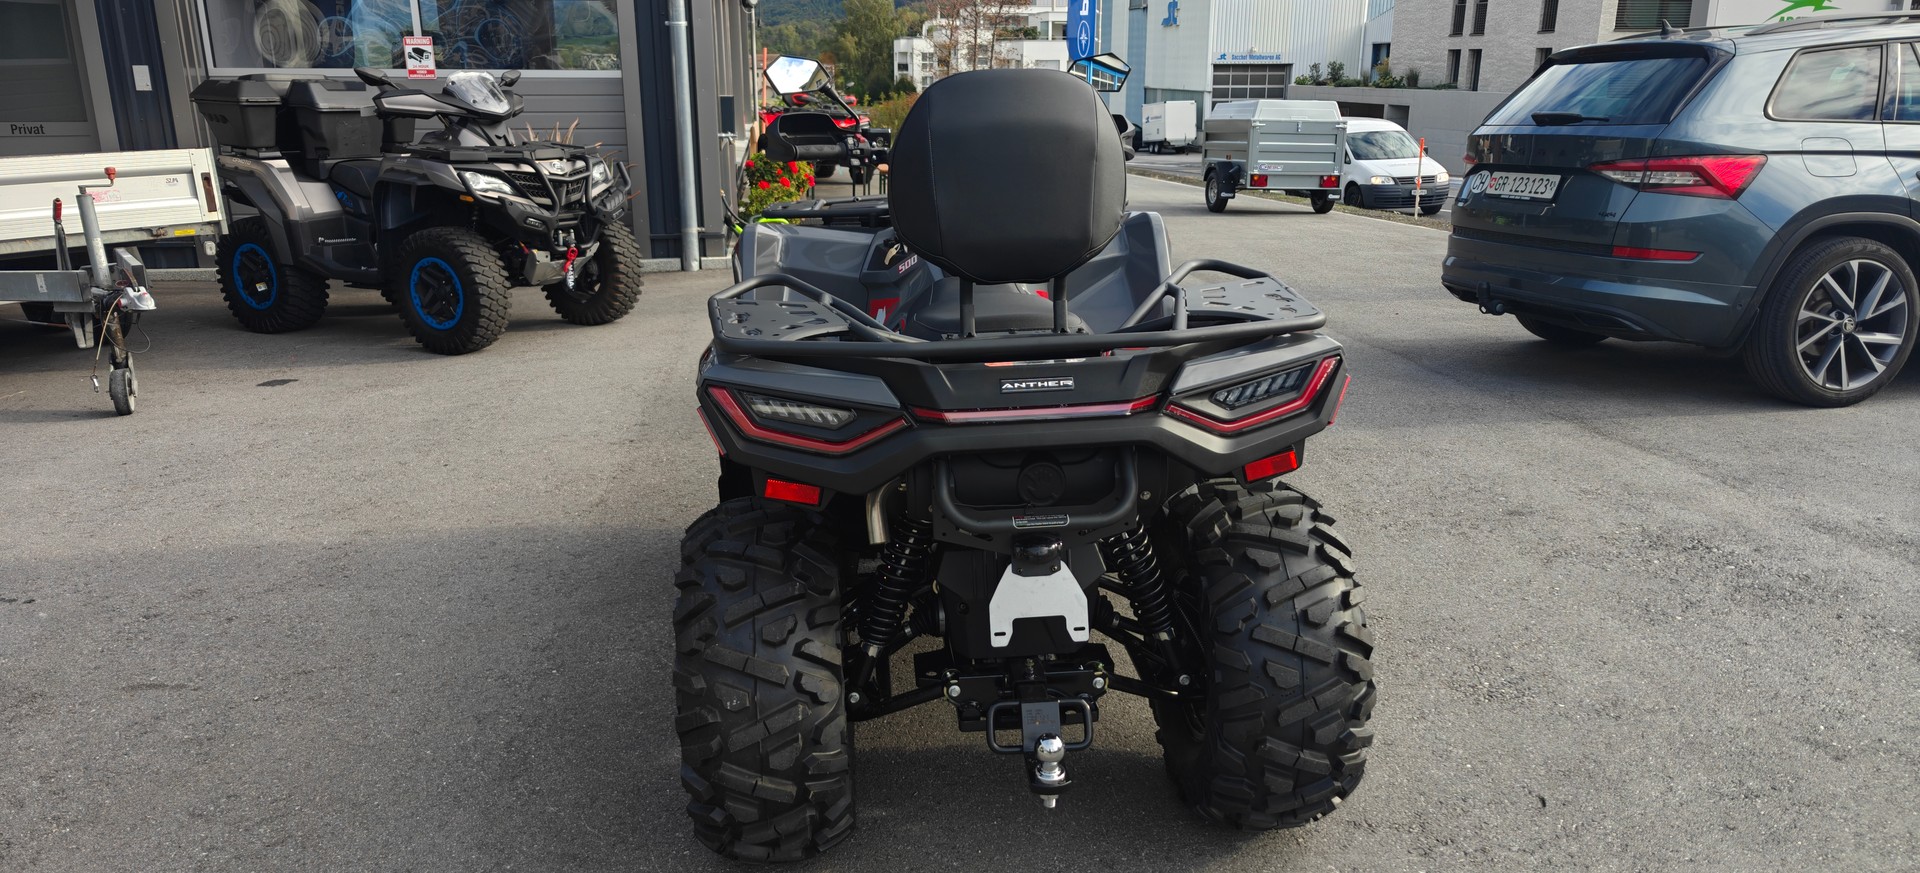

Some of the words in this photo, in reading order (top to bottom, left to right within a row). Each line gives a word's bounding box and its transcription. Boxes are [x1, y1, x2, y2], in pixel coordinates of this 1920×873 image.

[10, 123, 46, 135] Privat
[1472, 173, 1489, 190] CH
[898, 254, 918, 273] 500
[1001, 380, 1074, 389] ANTHER
